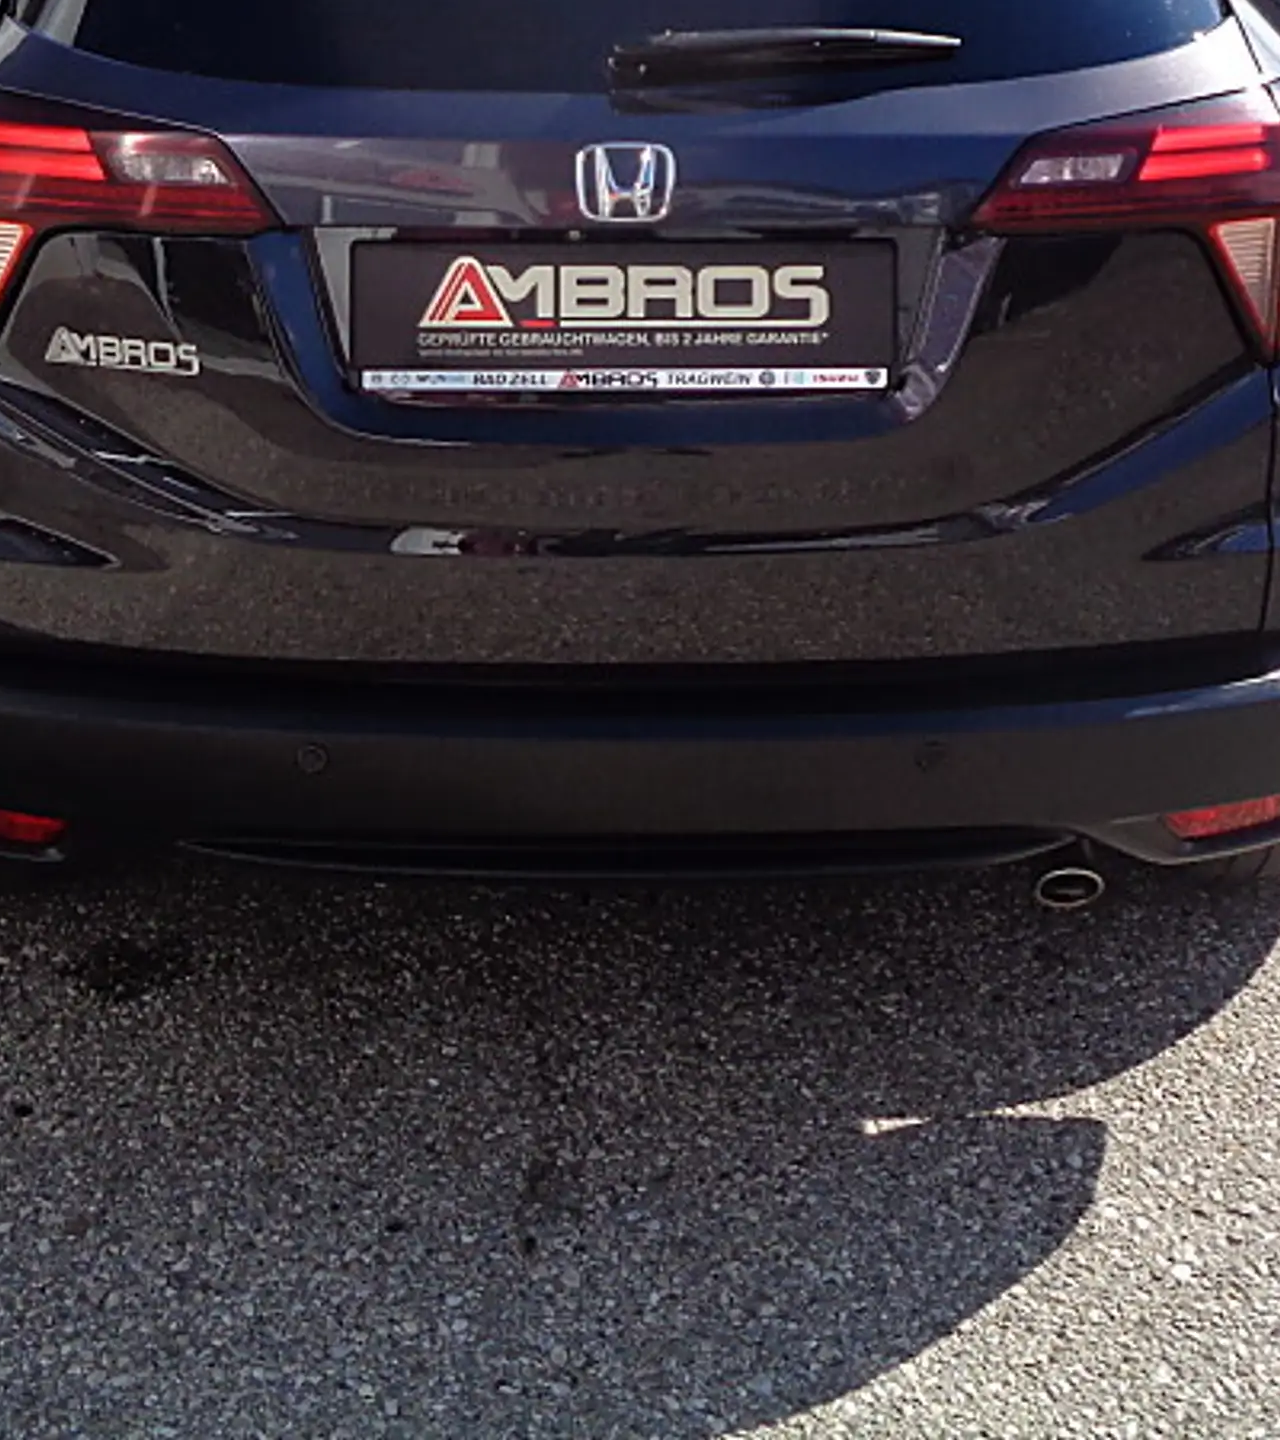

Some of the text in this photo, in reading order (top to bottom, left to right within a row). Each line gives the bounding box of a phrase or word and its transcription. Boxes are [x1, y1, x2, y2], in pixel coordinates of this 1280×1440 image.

[417, 256, 830, 327] AMBROS
[44, 326, 200, 376] AMBROS
[418, 330, 497, 347] GEPRÜFTE
[655, 332, 680, 347] BIS
[682, 332, 692, 346] 2
[694, 332, 744, 346] JAHRE
[473, 373, 507, 386] BAD
[558, 368, 658, 387] AMBROS
